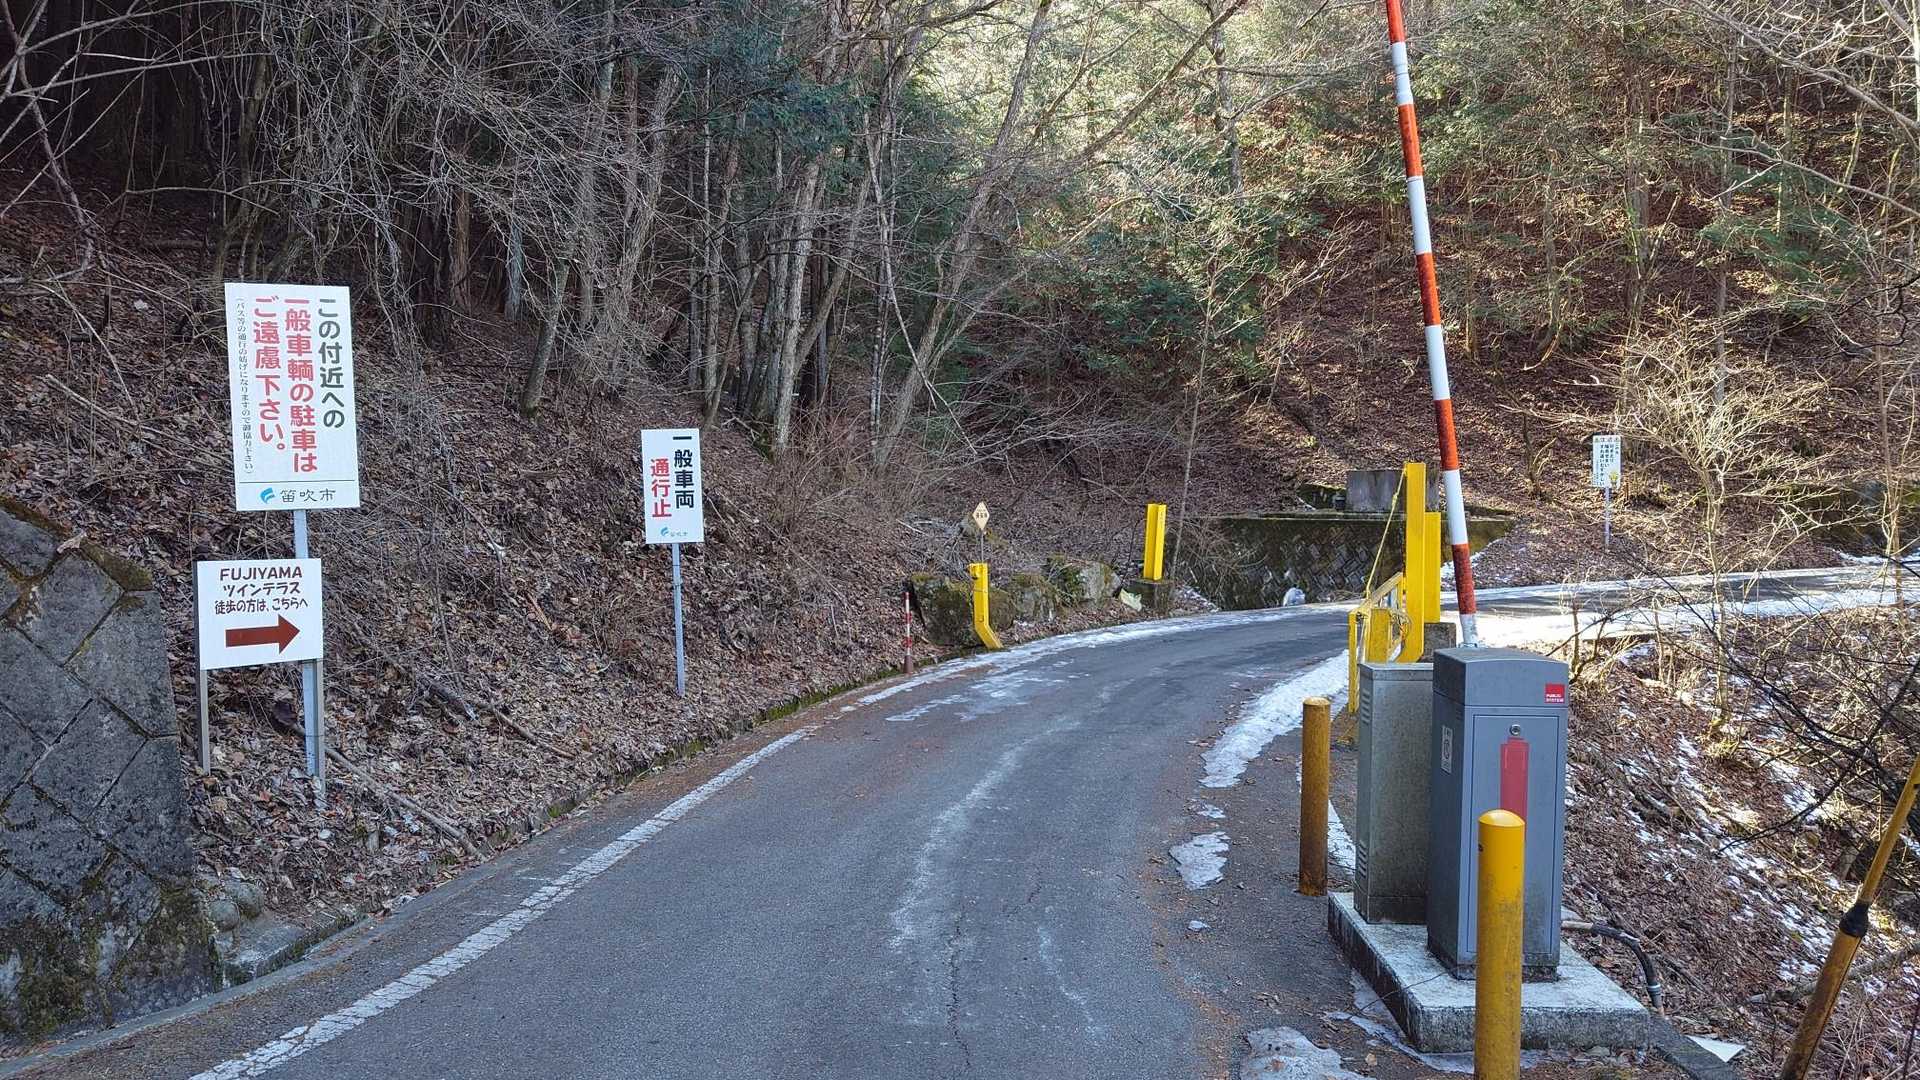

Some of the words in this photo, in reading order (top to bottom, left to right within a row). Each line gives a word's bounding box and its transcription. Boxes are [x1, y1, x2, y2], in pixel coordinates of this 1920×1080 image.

[253, 295, 286, 451] ご遠慮下さい。
[318, 298, 345, 429] この付近への
[650, 458, 672, 518] 通行止
[672, 435, 695, 509] 一般車両
[280, 488, 336, 503] 笛吹市
[220, 566, 303, 581] FUJIYAMA
[223, 581, 301, 598] ツインテラス
[215, 597, 308, 615] 徒歩の方は、こちらへ
